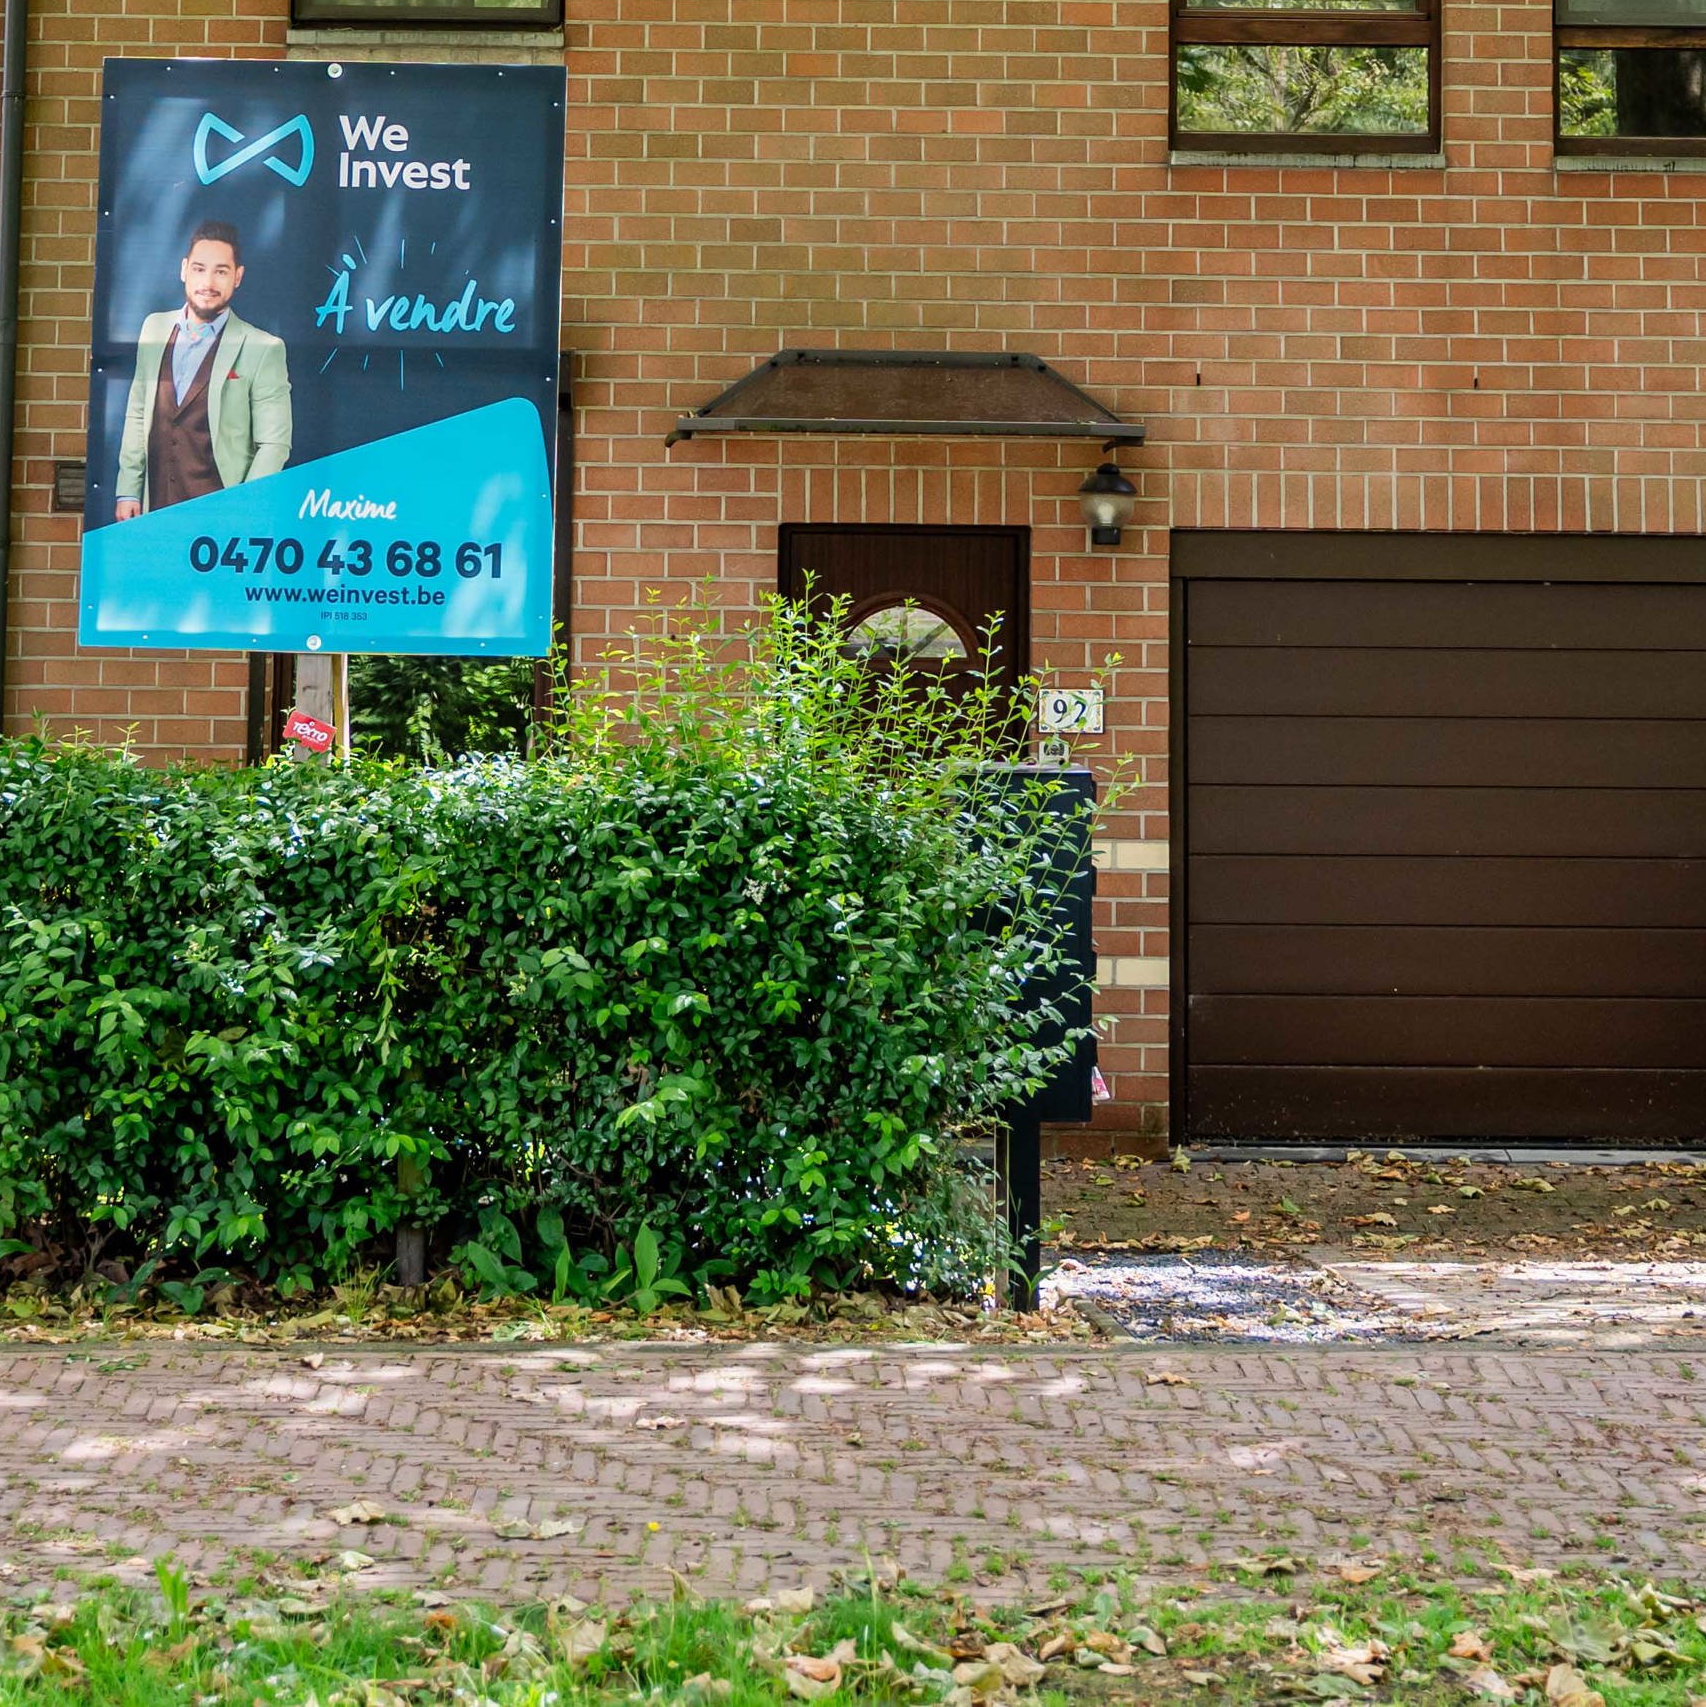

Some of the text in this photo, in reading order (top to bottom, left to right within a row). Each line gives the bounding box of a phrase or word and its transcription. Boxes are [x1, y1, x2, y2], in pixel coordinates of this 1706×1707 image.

[339, 115, 409, 152] We
[339, 152, 471, 190] Invest
[315, 254, 516, 334] À vendre
[298, 488, 398, 520] Maxime
[189, 536, 502, 579] 0470 43 68 61
[244, 584, 446, 606] www.weinvest.be
[1053, 699, 1086, 724] 92
